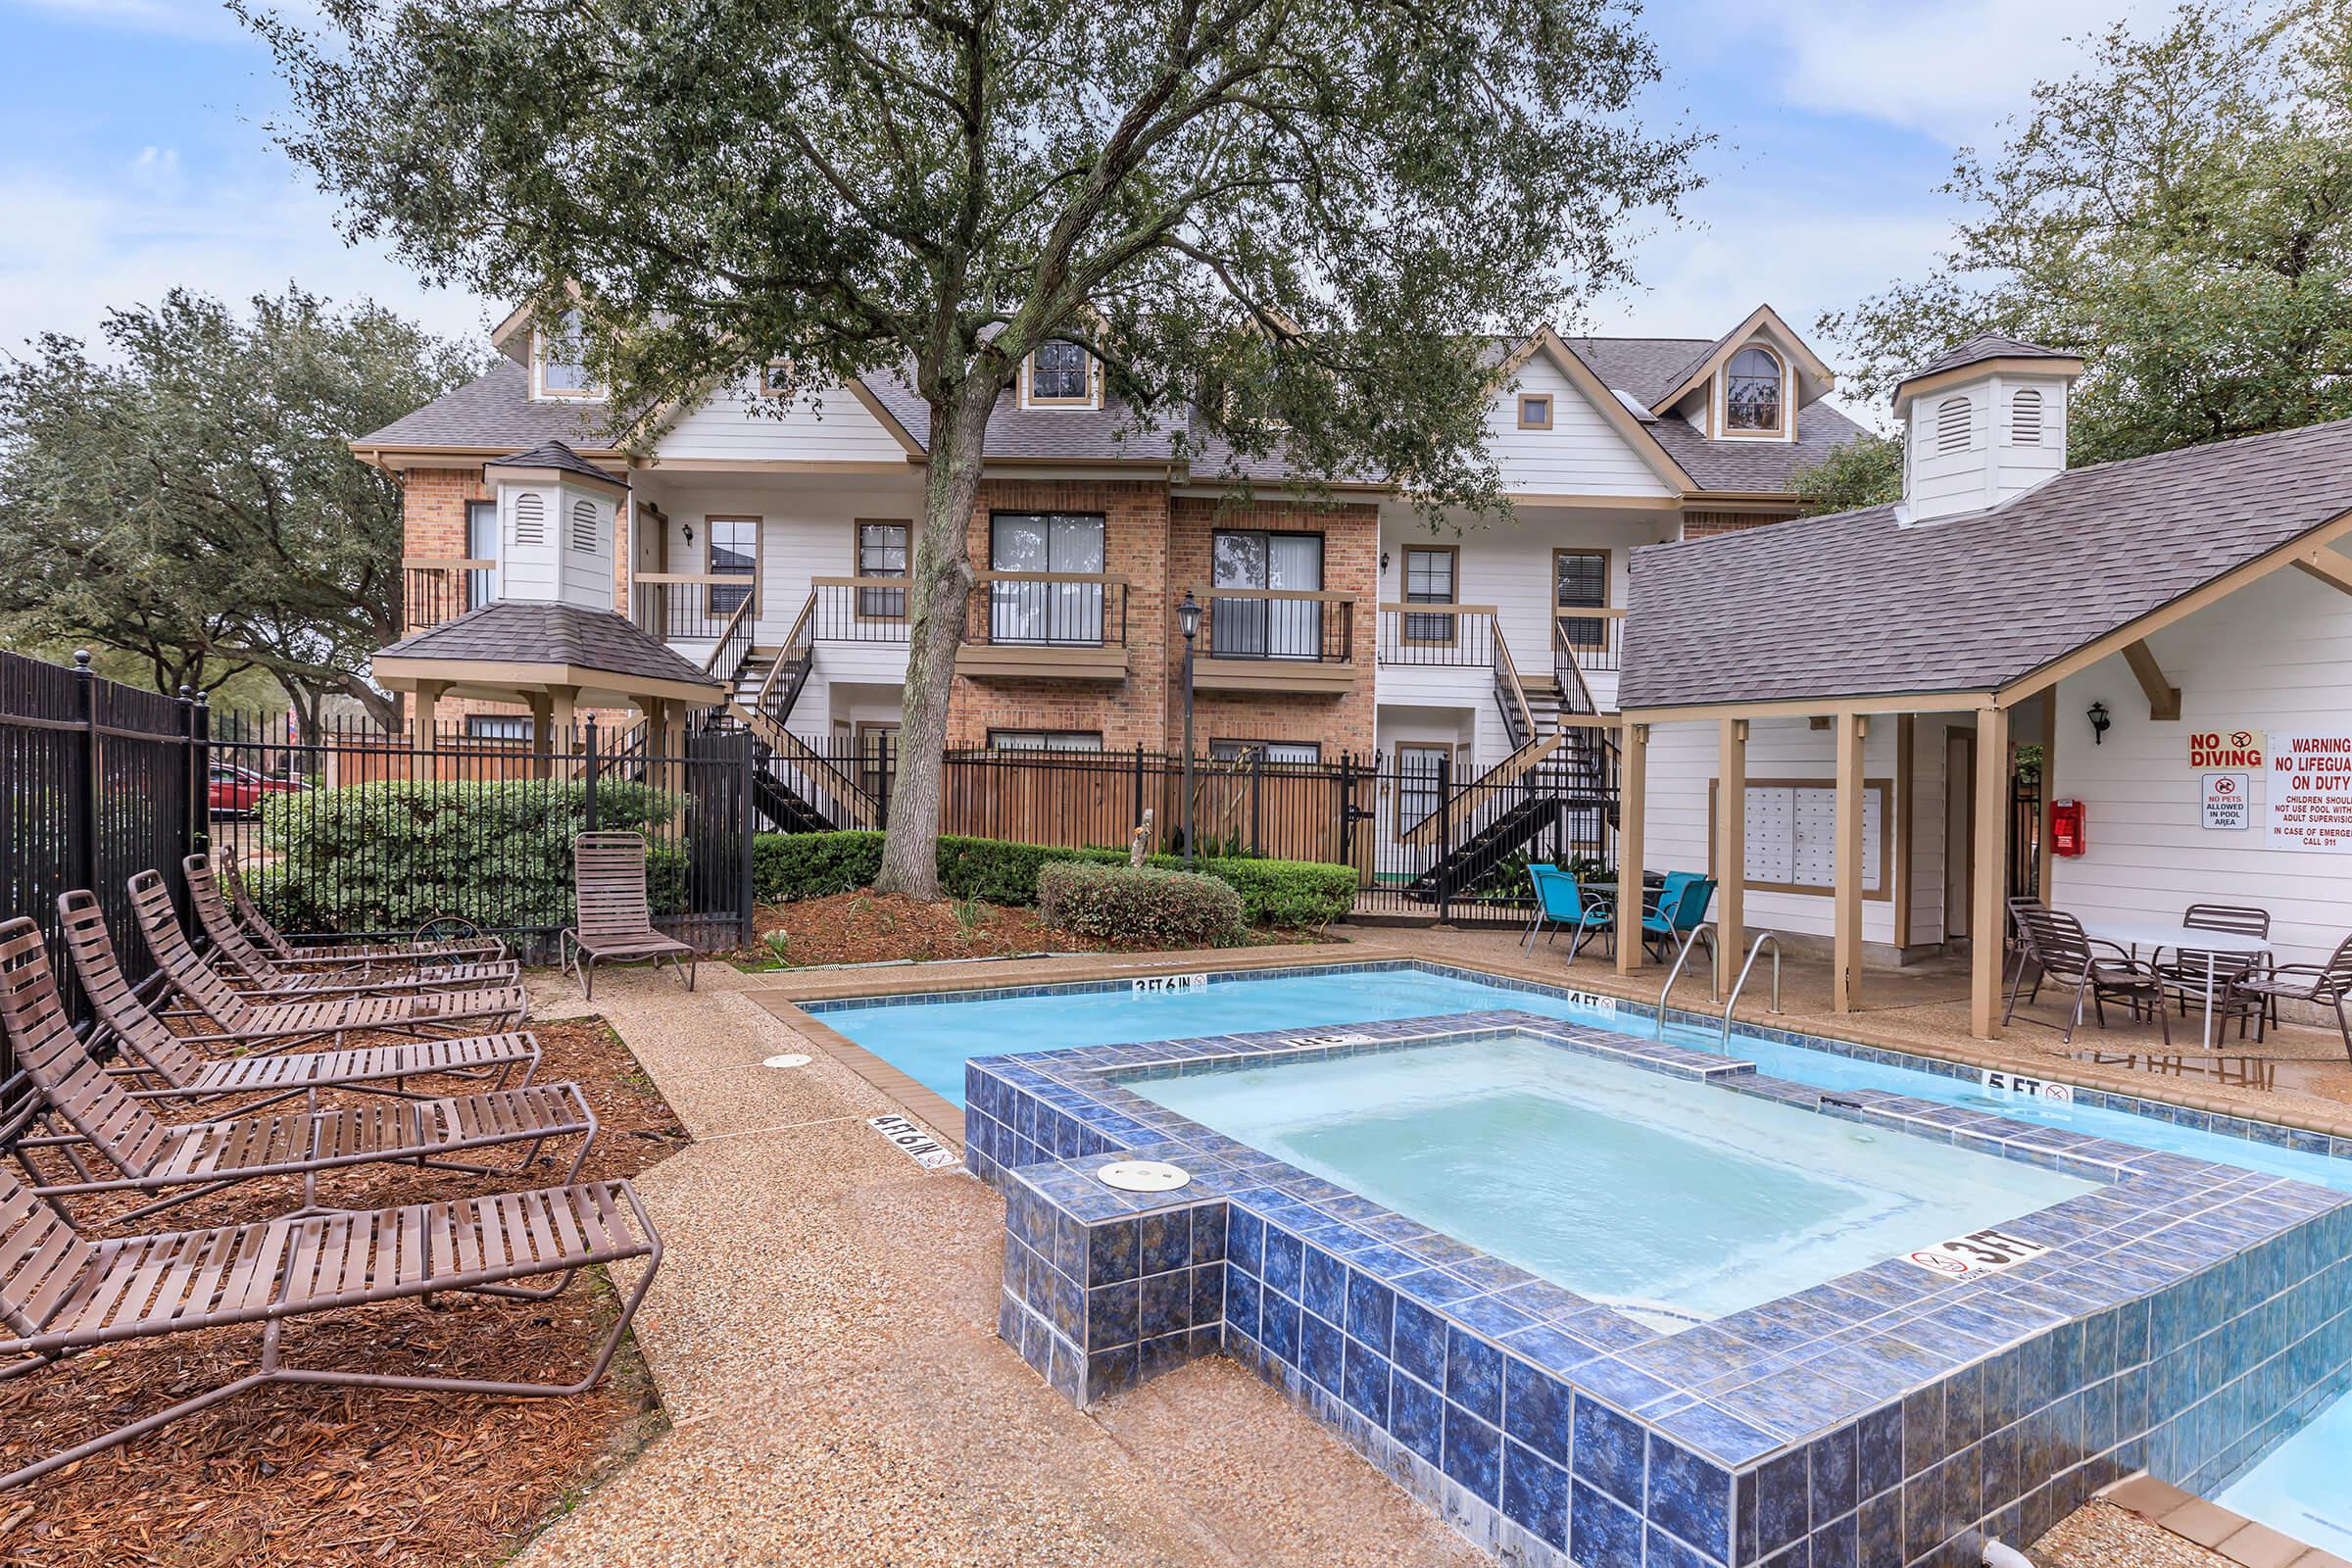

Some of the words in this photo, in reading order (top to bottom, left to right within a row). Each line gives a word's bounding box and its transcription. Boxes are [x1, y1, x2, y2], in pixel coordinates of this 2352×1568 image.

[2191, 733, 2220, 750] NO
[2292, 738, 2351, 753] WARNING
[2191, 750, 2262, 766] DIVING
[2276, 757, 2293, 771] NO
[2292, 775, 2310, 790] ON
[2316, 776, 2350, 791] DUTY
[2326, 796, 2352, 805] SHOUL
[2284, 827, 2303, 836] CASE
[1179, 976, 1190, 989] IN
[874, 1117, 903, 1126] 4
[896, 1136, 928, 1145] 6
[1942, 1242, 2011, 1264] 3
